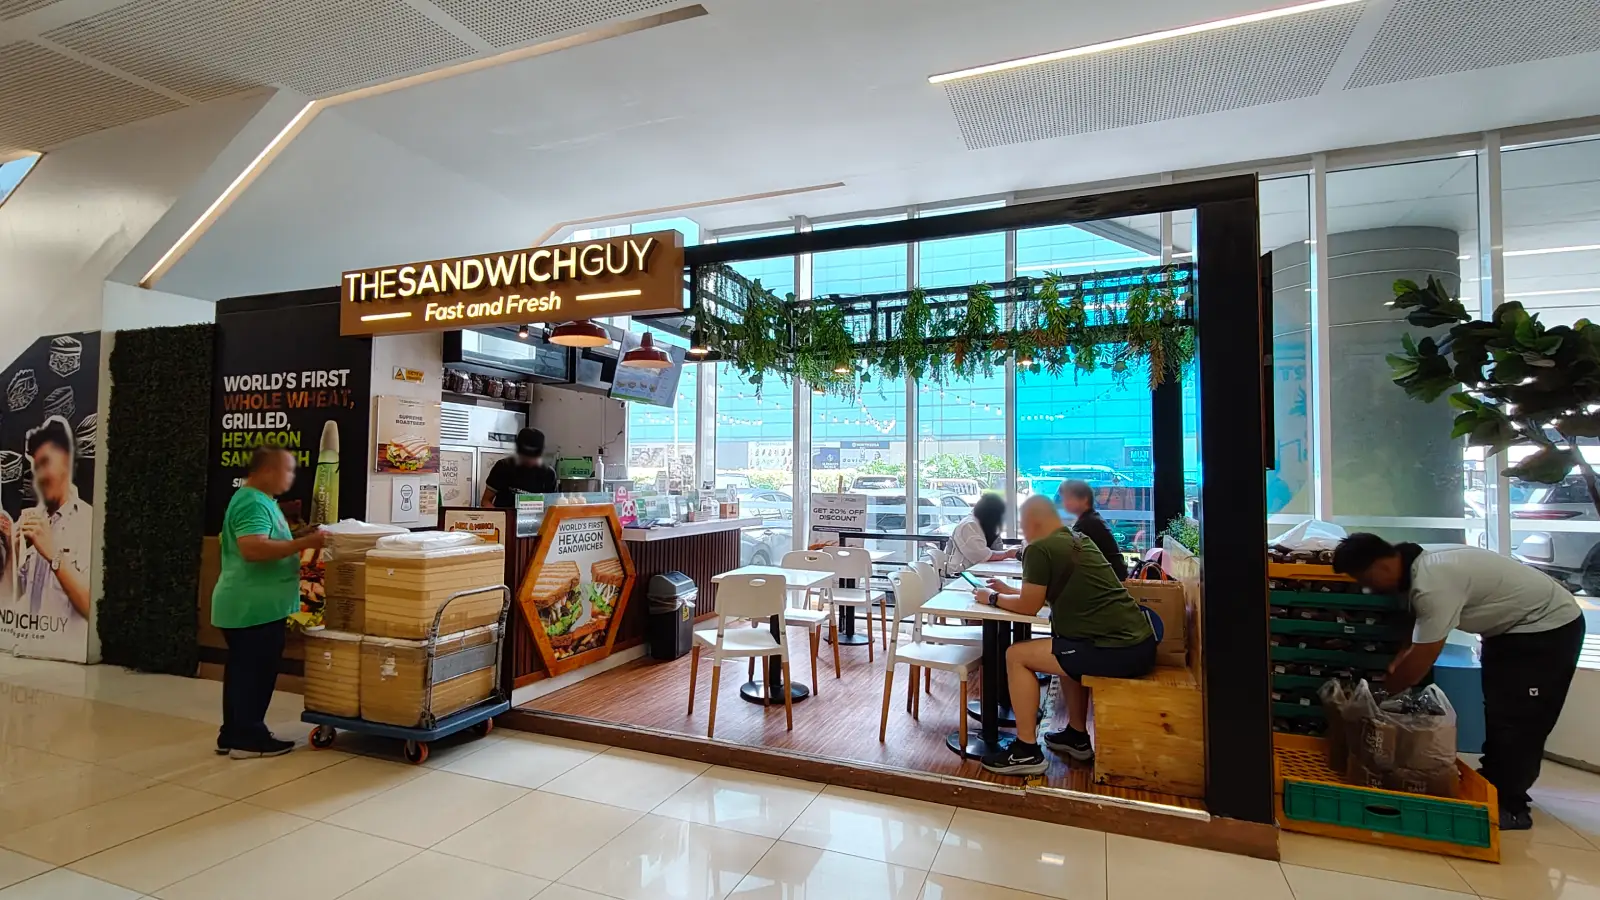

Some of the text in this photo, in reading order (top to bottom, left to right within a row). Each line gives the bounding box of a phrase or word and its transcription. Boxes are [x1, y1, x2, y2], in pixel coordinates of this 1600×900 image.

[344, 238, 654, 302] THESANDWICHGUY
[424, 291, 562, 322] Fast and Fresh
[223, 369, 350, 392] WORLD'S FIRST
[223, 389, 355, 411] WHOLE WHEAT,
[222, 411, 291, 430] GRILLED,
[221, 431, 301, 449] HEXAGON
[559, 521, 604, 532] WORLD'S FIRST
[819, 514, 858, 522] DISCOUNT
[558, 531, 604, 546] HEXAGON
[558, 541, 604, 555] SANDWICHES
